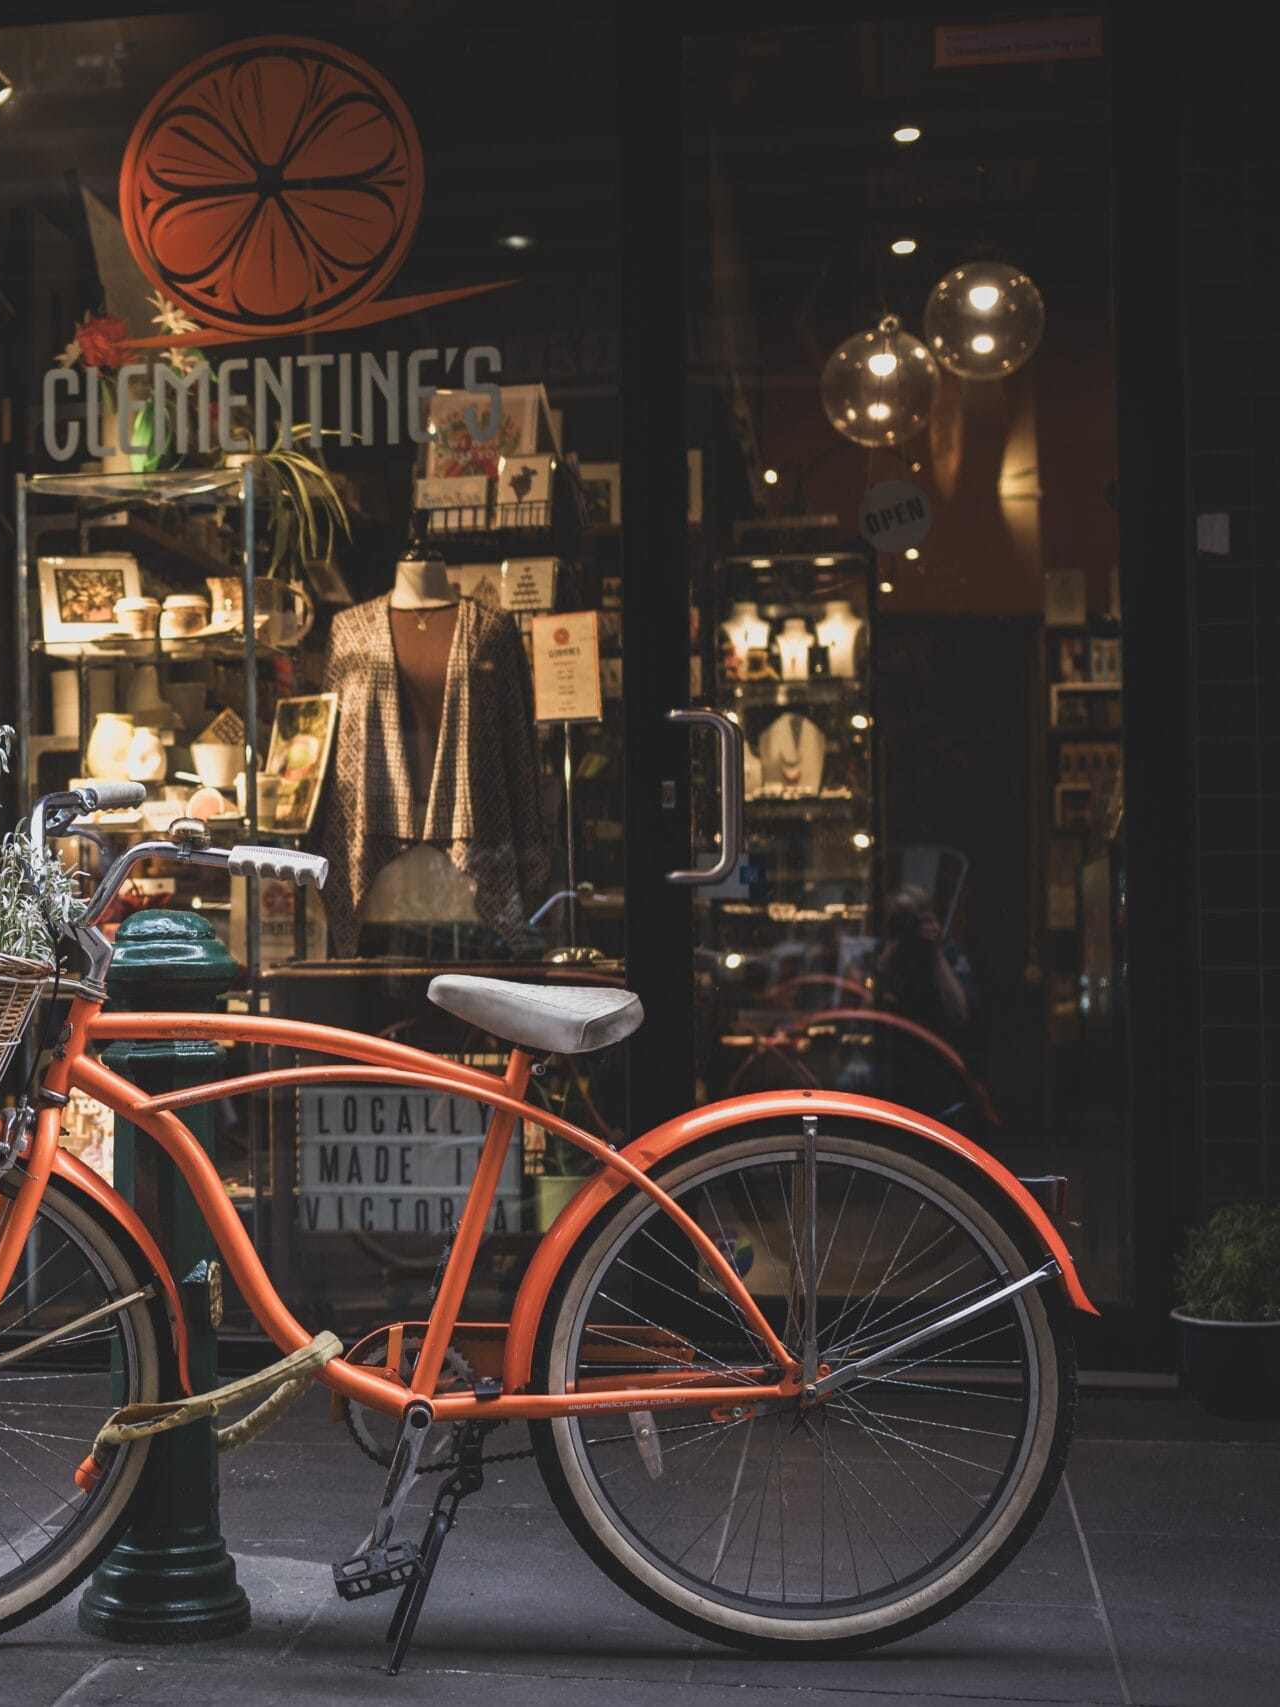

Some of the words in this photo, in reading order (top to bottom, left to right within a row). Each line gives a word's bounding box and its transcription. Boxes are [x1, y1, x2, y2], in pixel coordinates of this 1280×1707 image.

[43, 346, 502, 461] CLEMENTINE'S
[865, 497, 925, 534] OPEN
[318, 1096, 494, 1134] LOCALLY
[320, 1145, 413, 1185] MADE
[455, 1146, 483, 1186] I
[305, 1196, 507, 1233] VICTORA
[568, 1397, 687, 1411] www.reidcycles.com.au
